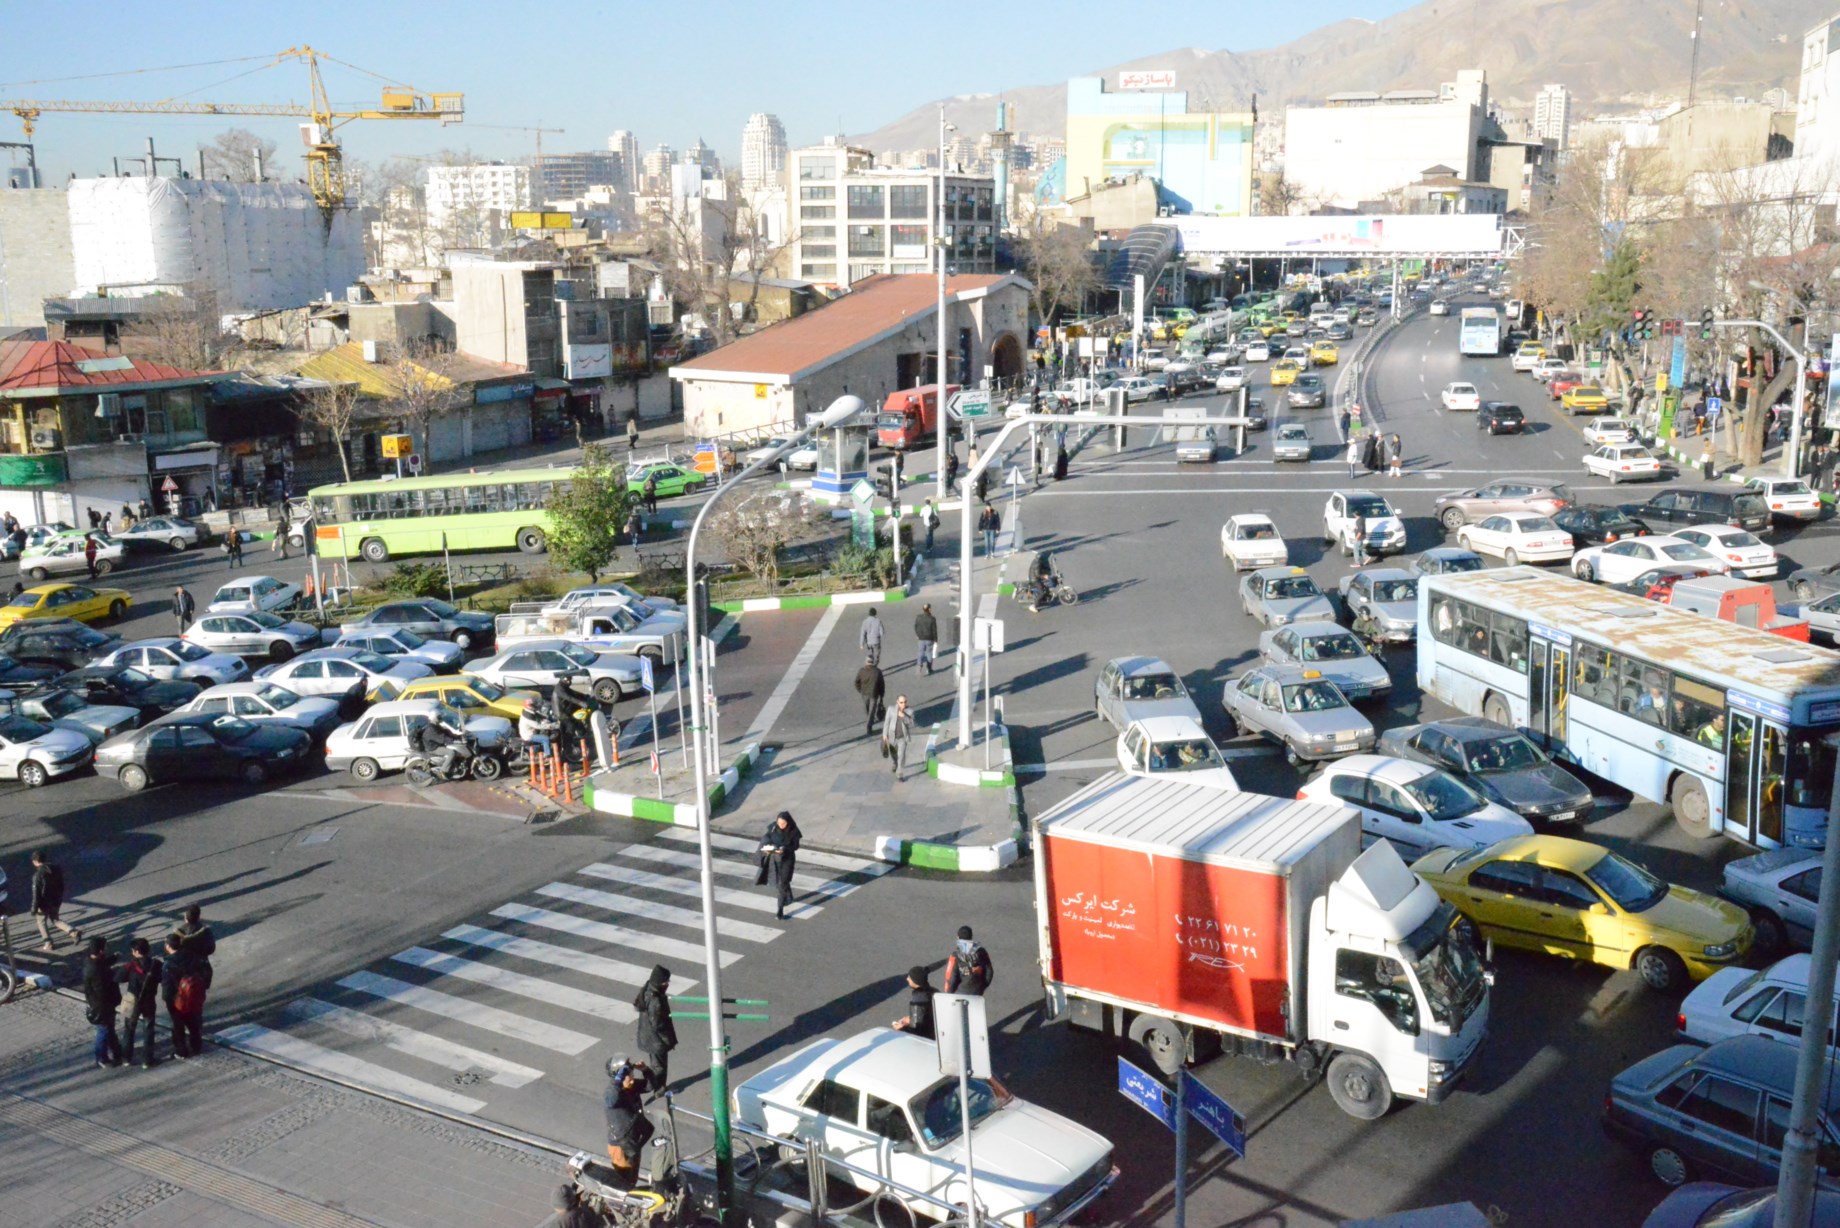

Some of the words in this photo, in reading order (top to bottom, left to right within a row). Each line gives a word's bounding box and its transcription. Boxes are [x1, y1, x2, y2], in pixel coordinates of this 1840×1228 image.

[1144, 73, 1172, 87] پاساژ
[1101, 899, 1136, 917] شرکت
[1206, 919, 1219, 932] ۶۱
[1223, 923, 1238, 936] ۷۱
[1242, 927, 1257, 938] ۲۰
[1241, 945, 1257, 959] ۲۹
[1126, 1075, 1157, 1100] شریعتی
[1198, 1102, 1225, 1128] باهنر
